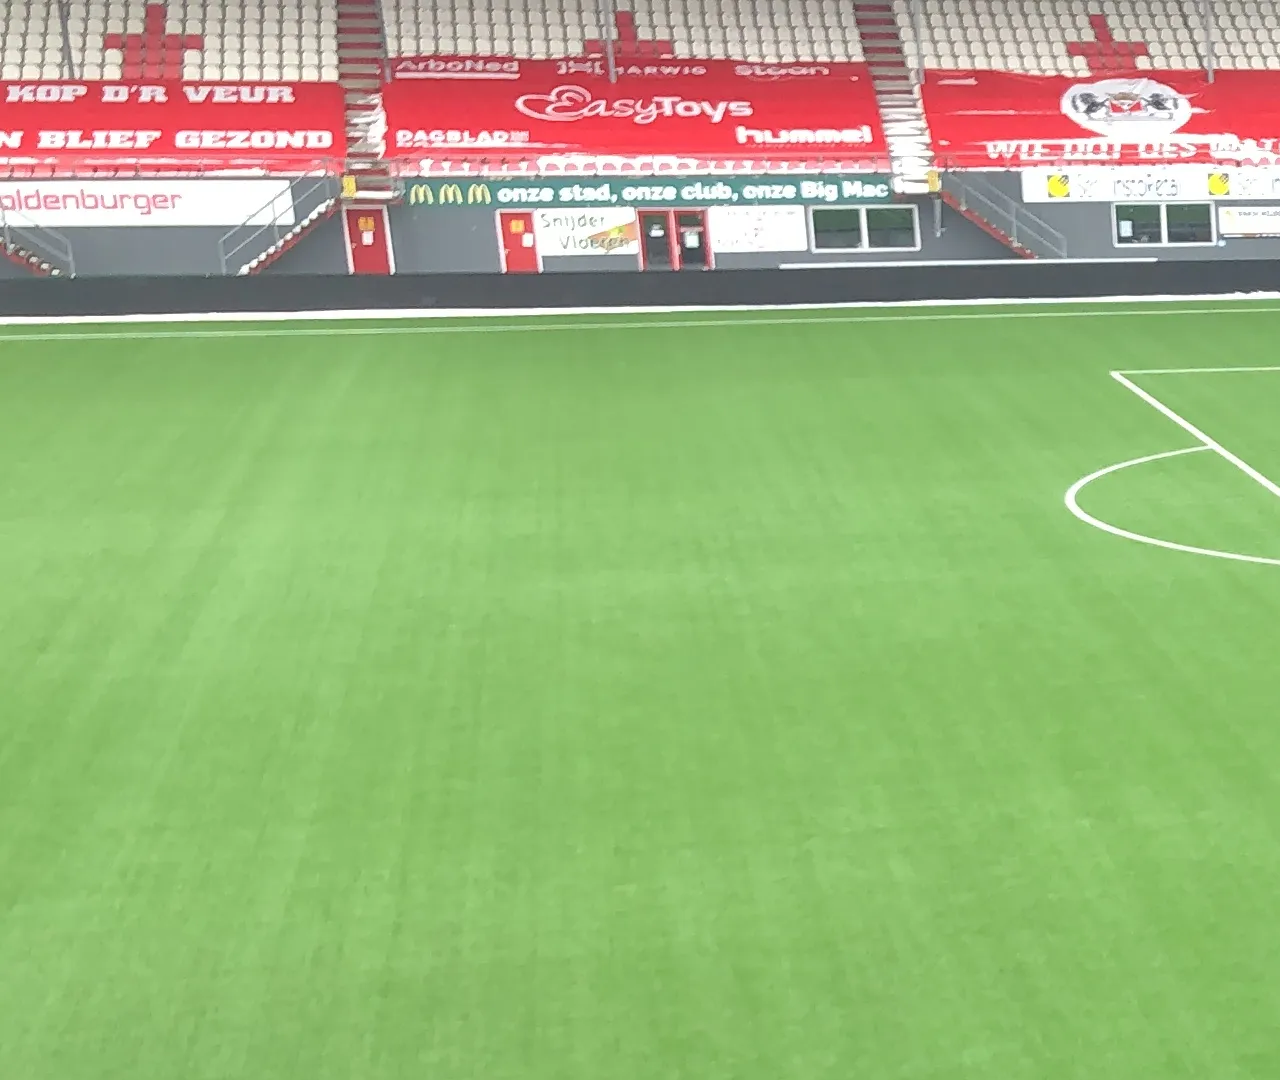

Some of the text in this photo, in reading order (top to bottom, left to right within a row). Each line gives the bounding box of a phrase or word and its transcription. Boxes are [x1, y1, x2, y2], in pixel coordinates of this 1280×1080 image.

[6, 85, 296, 103] KOP D'R VEUR
[515, 86, 753, 124] EasyToys
[37, 130, 162, 149] BLIEF
[174, 130, 333, 149] GEZOND
[735, 125, 872, 143] hummel
[497, 186, 553, 202] onze
[559, 184, 617, 203] stad,
[621, 185, 677, 201] onze
[681, 181, 738, 201] club,
[743, 183, 796, 199] onze
[801, 180, 838, 201] Big
[842, 181, 888, 198] Mac
